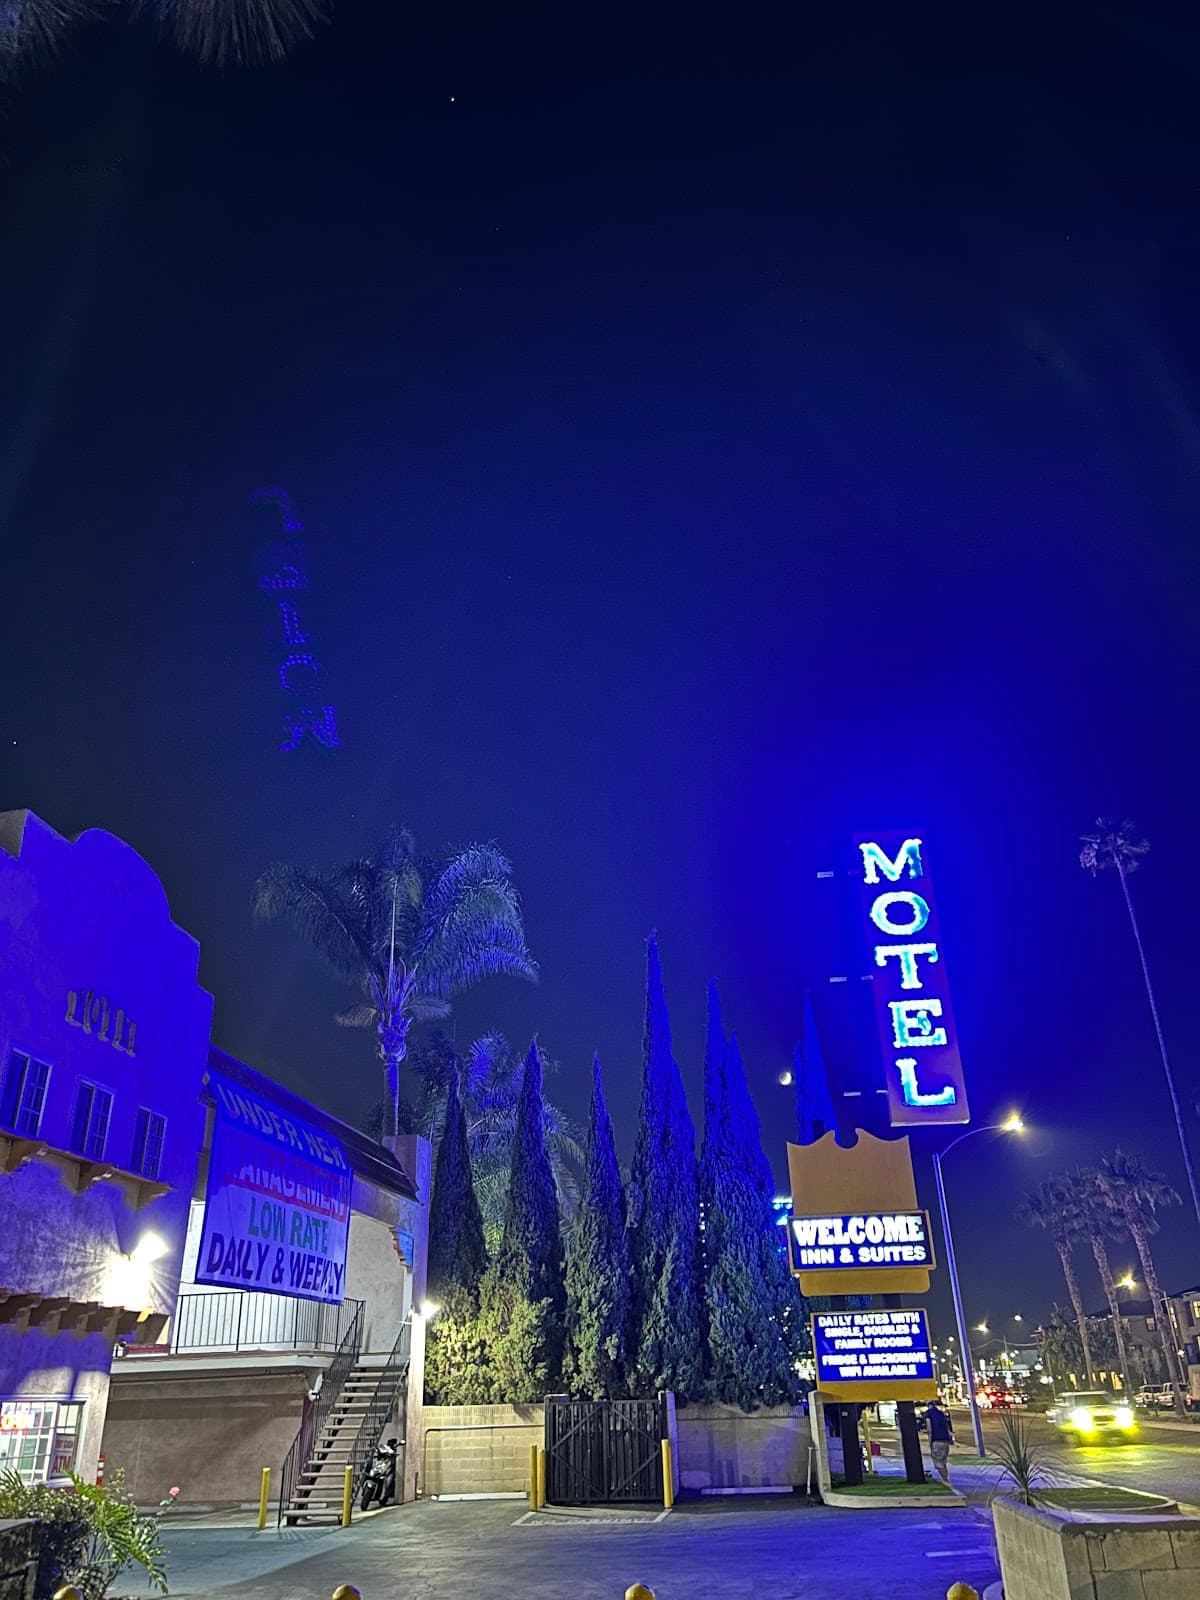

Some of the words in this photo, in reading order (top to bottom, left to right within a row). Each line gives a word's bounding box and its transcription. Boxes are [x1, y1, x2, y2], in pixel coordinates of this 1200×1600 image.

[858, 838, 957, 1107] MOTEL
[217, 1083, 303, 1151] UNDER
[301, 1128, 347, 1171] NEW
[248, 1197, 286, 1244] LOW
[289, 1210, 330, 1254] RATE
[792, 1216, 925, 1246] WELCOME
[206, 1232, 270, 1281] DAILY
[271, 1247, 284, 1284] &
[289, 1251, 344, 1295] WEEKLY
[800, 1247, 835, 1265] INN
[838, 1247, 854, 1263] &
[858, 1245, 927, 1263] SUITES
[818, 1315, 852, 1327] DAILY
[853, 1313, 889, 1326] RATES
[890, 1311, 921, 1324] WITH
[824, 1326, 863, 1338] SINGLE,
[863, 1324, 910, 1336] DOUBLES
[911, 1323, 921, 1334] &
[834, 1338, 872, 1350] FAMILY
[873, 1336, 913, 1348] ROOMS
[858, 1353, 868, 1365] &
[867, 1352, 927, 1364] MICROWAVE
[862, 1364, 918, 1377] AVAILABLE
